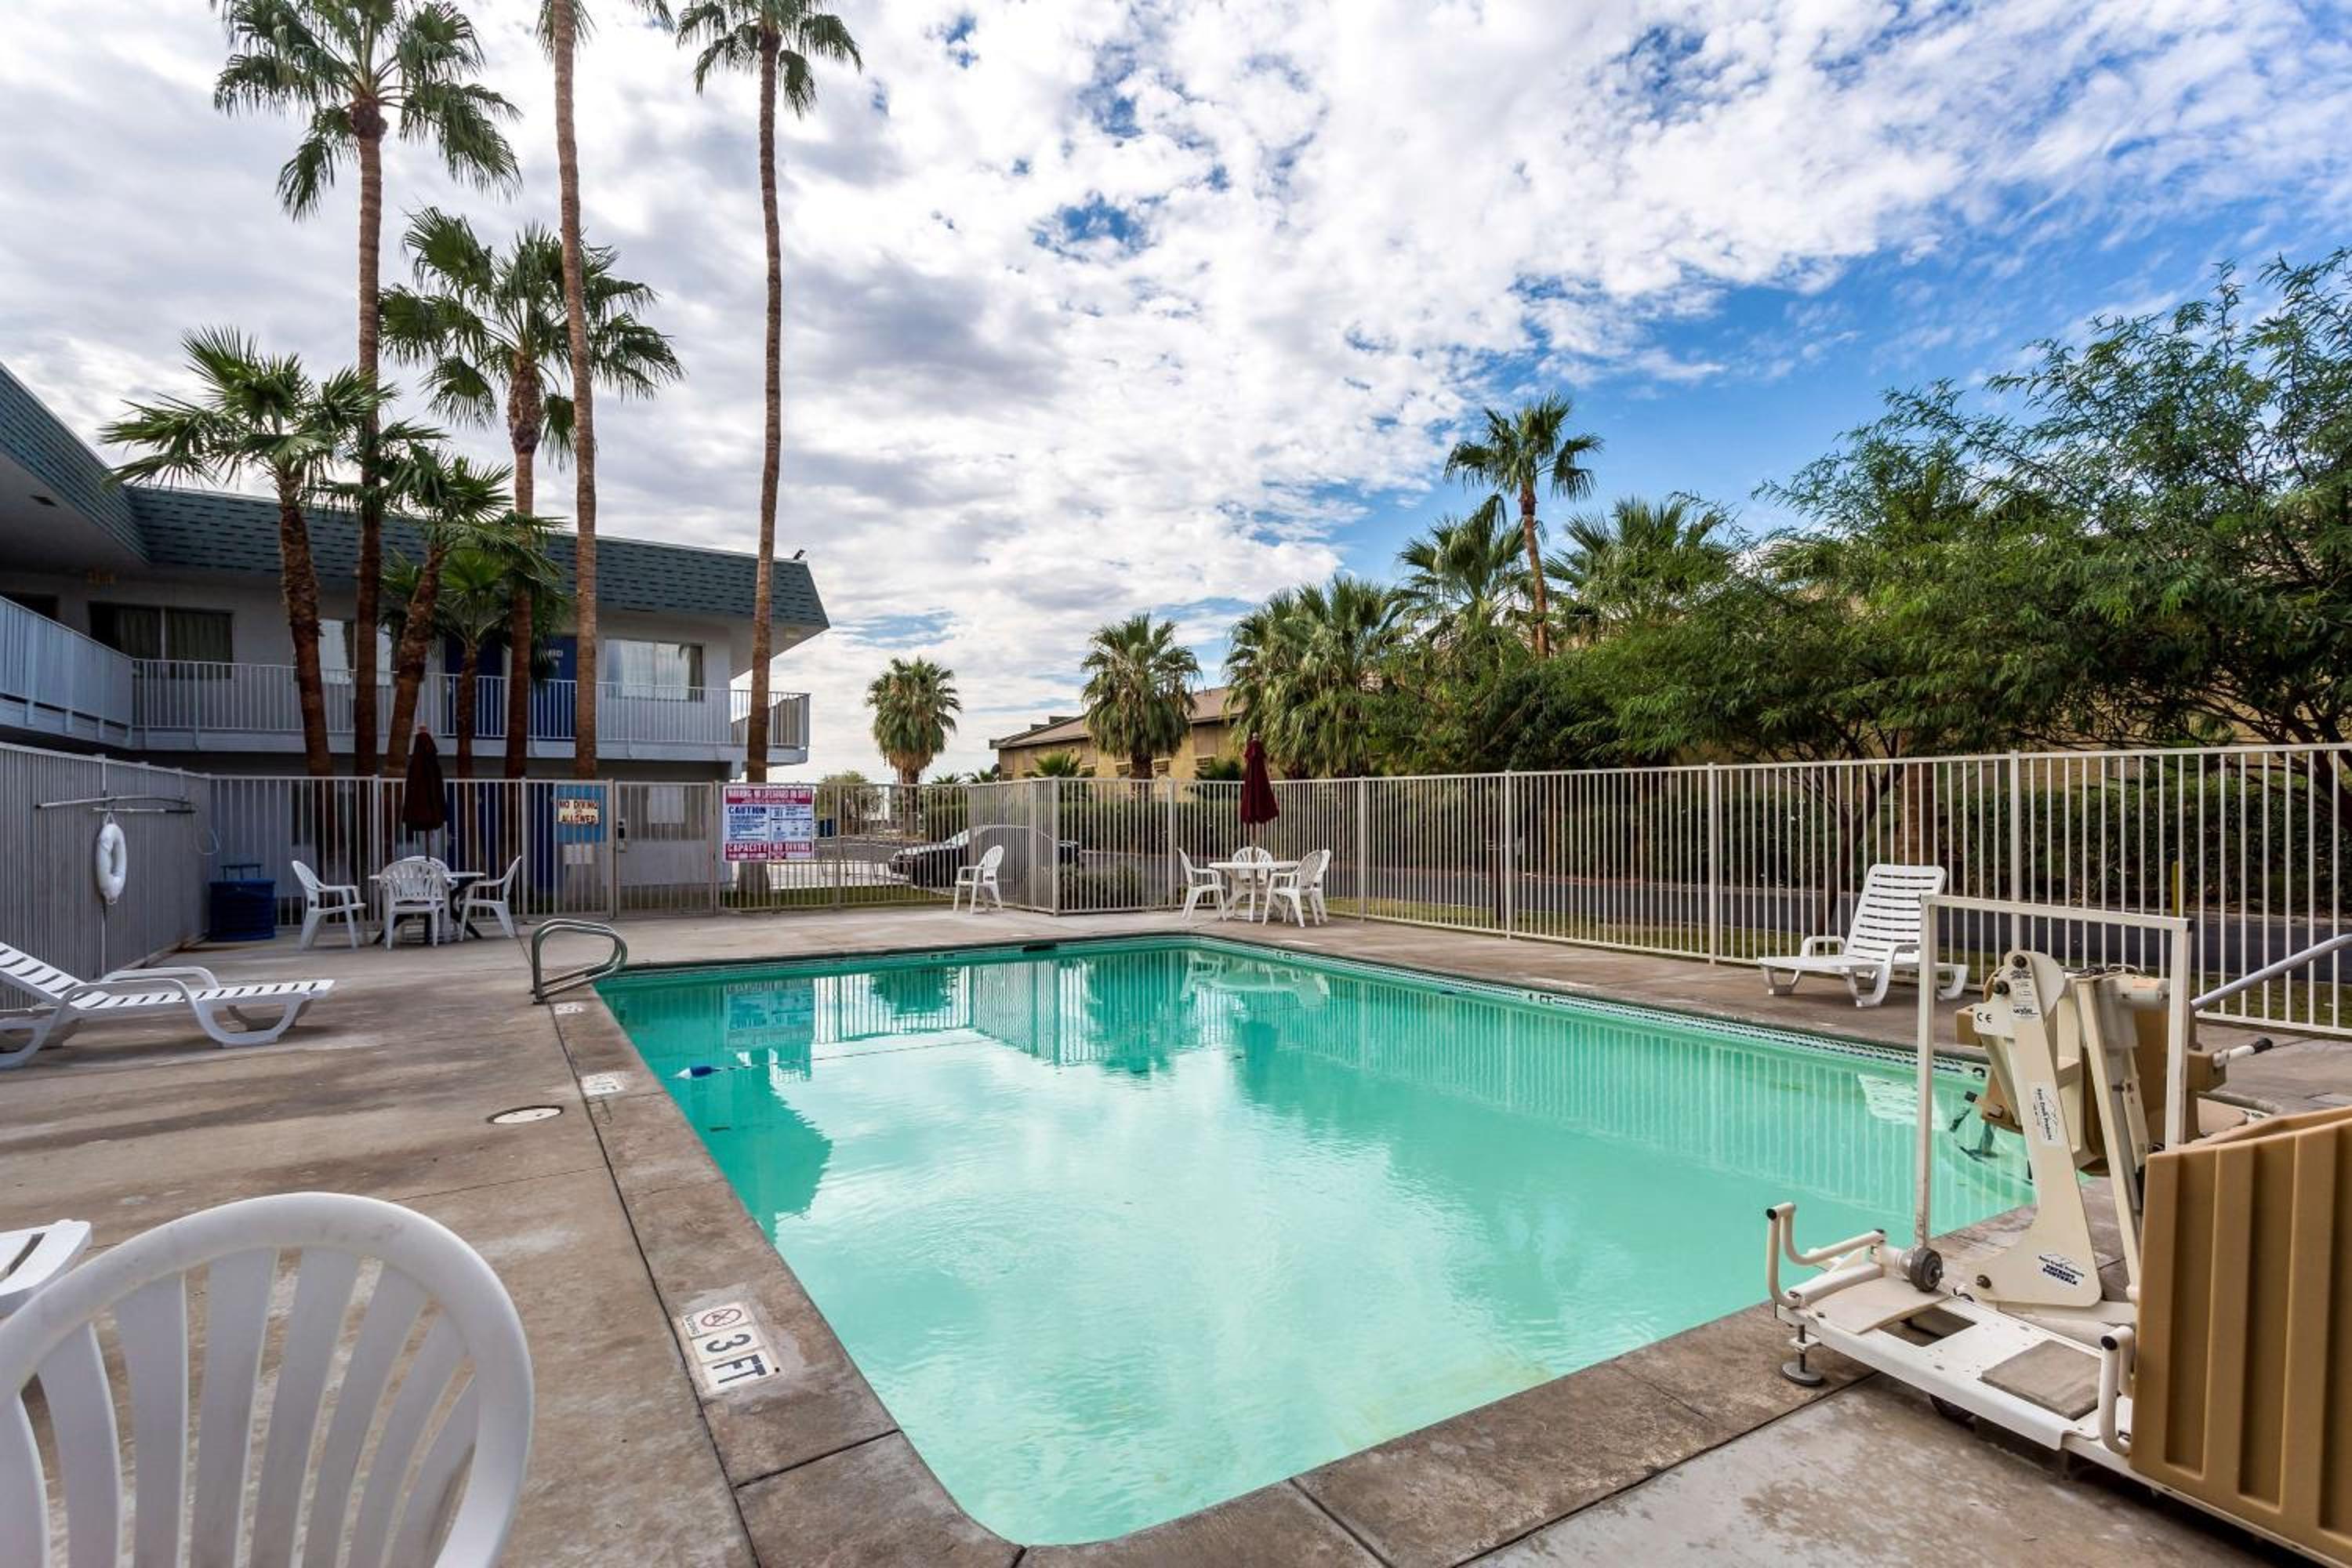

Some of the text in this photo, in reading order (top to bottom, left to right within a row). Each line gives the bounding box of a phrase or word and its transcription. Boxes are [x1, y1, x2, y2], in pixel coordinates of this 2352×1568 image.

[559, 800, 598, 810] NO DIVING
[728, 806, 766, 815] CAUTION
[561, 815, 597, 825] ALLOWED
[728, 844, 767, 852] CAPACITY
[785, 842, 810, 851] DIVING
[1976, 1012, 1992, 1023] CE
[706, 1334, 768, 1385] 3 FT
